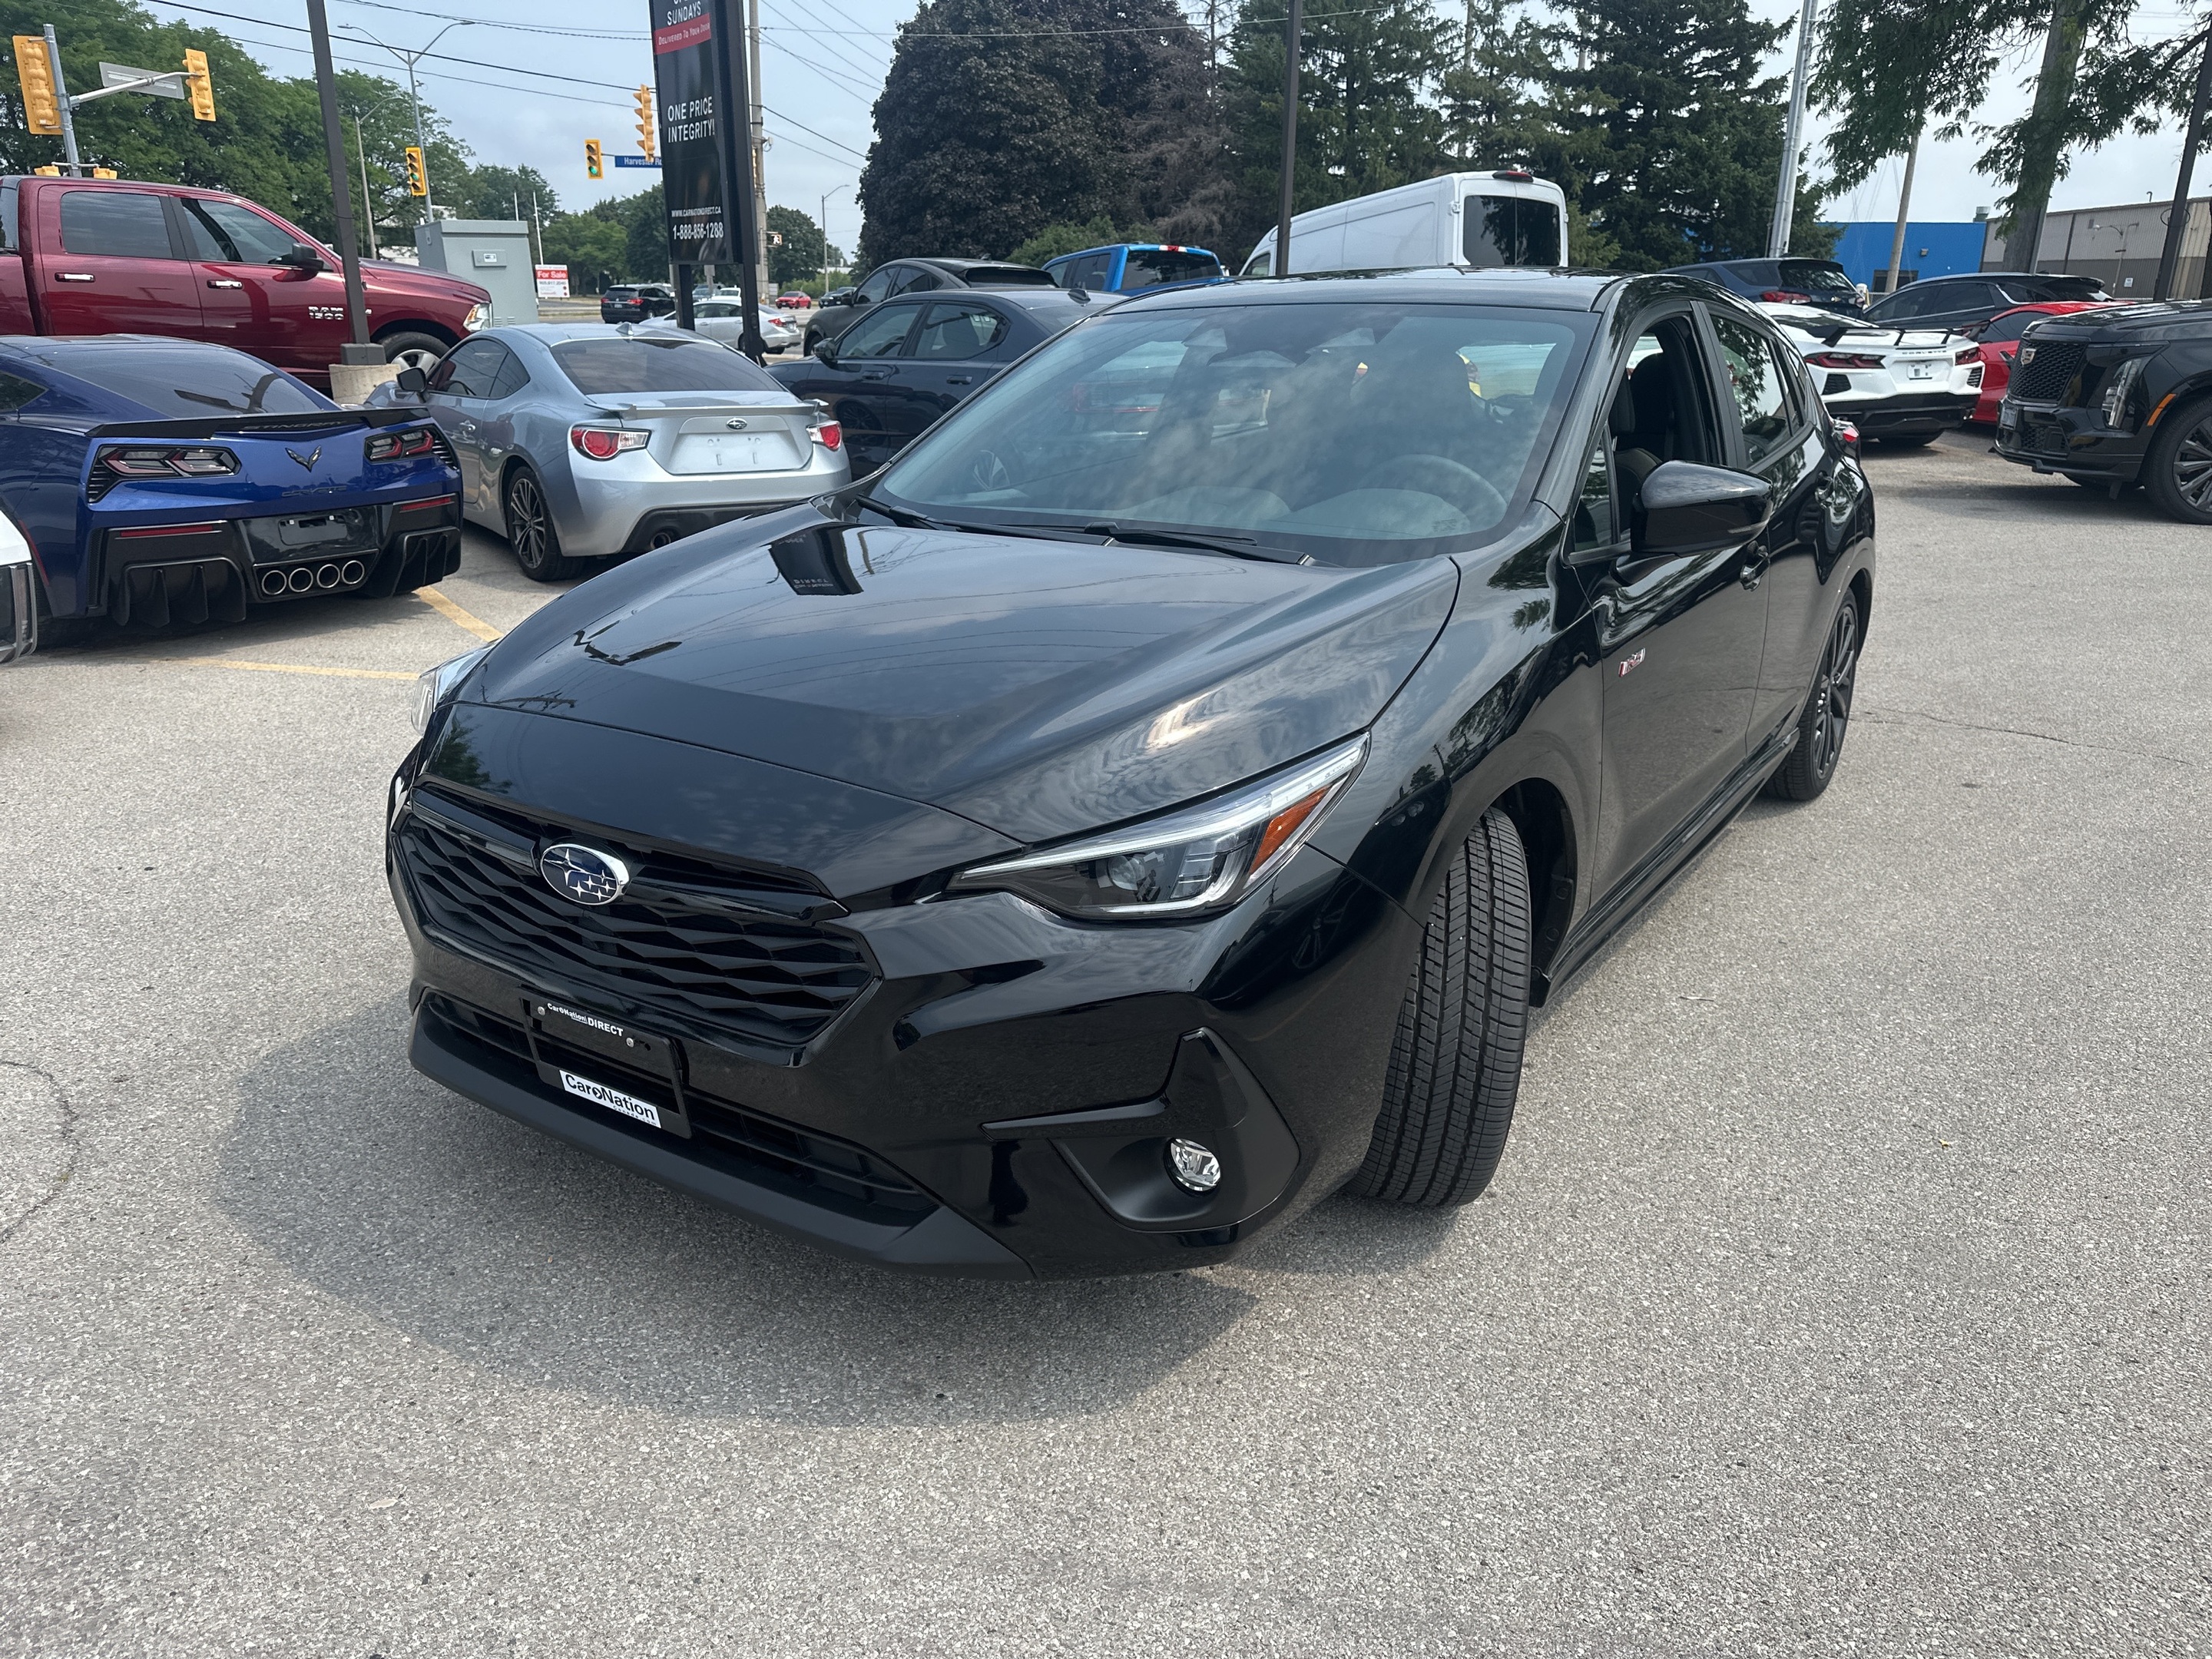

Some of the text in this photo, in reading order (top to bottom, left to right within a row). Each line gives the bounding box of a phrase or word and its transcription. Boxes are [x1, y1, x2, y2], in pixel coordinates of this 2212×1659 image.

[667, 1, 701, 26] SUNDAYS
[667, 96, 713, 122] ONE PRICE
[667, 118, 715, 144] INTEGRITY!
[673, 221, 724, 240] 1-888-856-1288
[550, 270, 567, 279] Sale
[243, 421, 346, 430] STINGRAY
[587, 1017, 624, 1037] DIRECT
